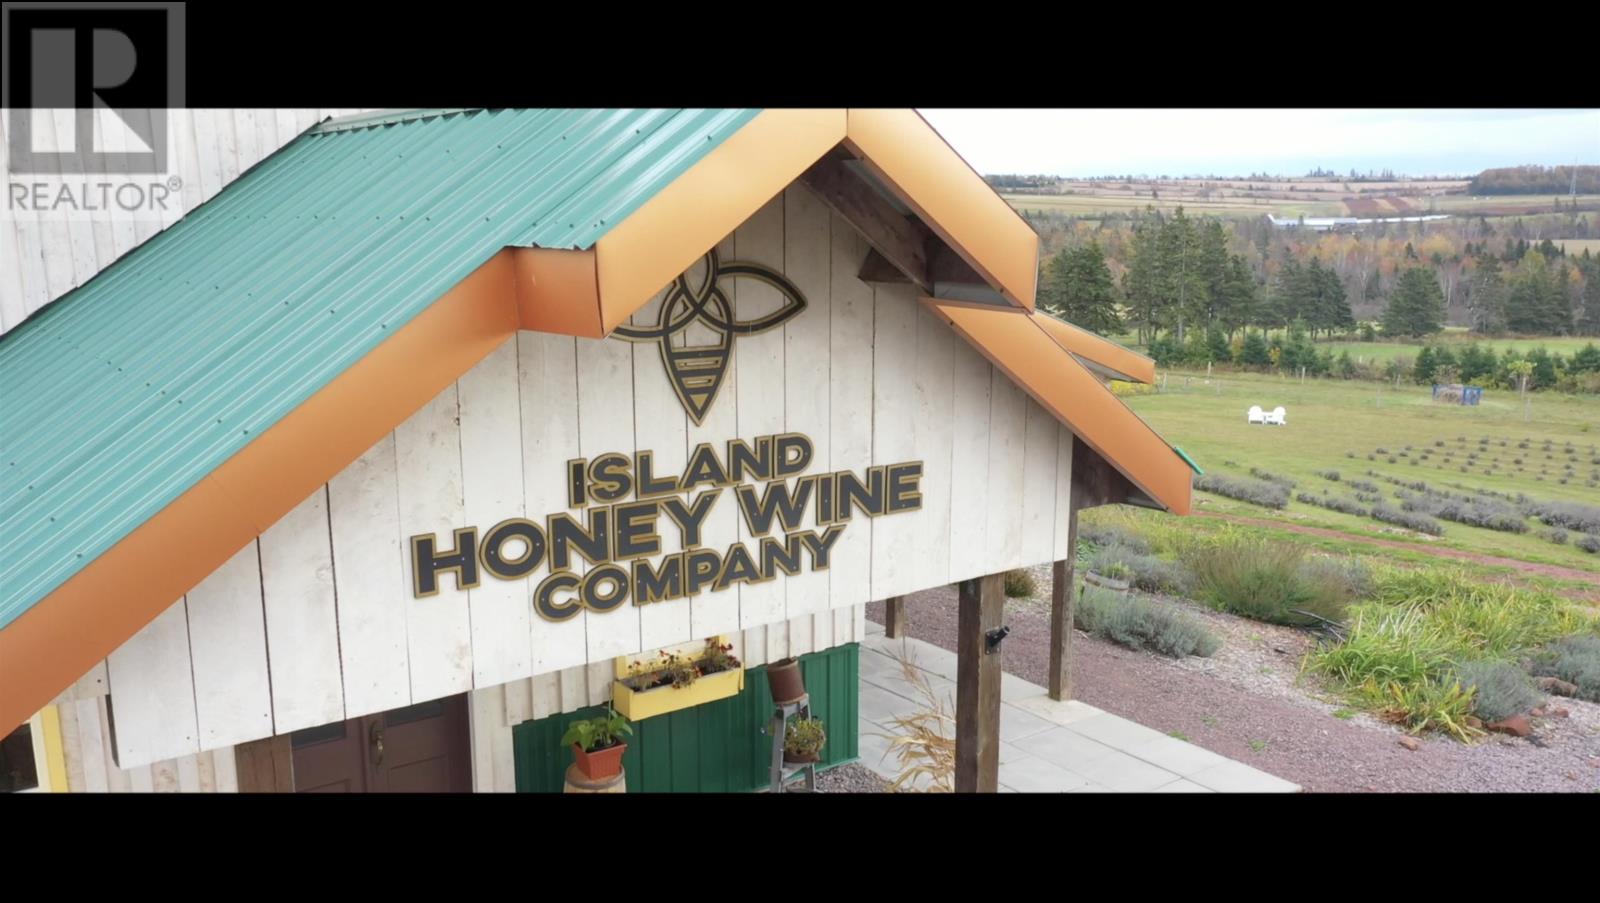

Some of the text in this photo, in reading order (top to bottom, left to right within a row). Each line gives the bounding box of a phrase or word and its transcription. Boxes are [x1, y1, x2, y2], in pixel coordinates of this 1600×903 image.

[567, 432, 814, 508] ISLAND
[410, 461, 923, 598] HONEY WINE
[533, 524, 846, 622] COMPANY
